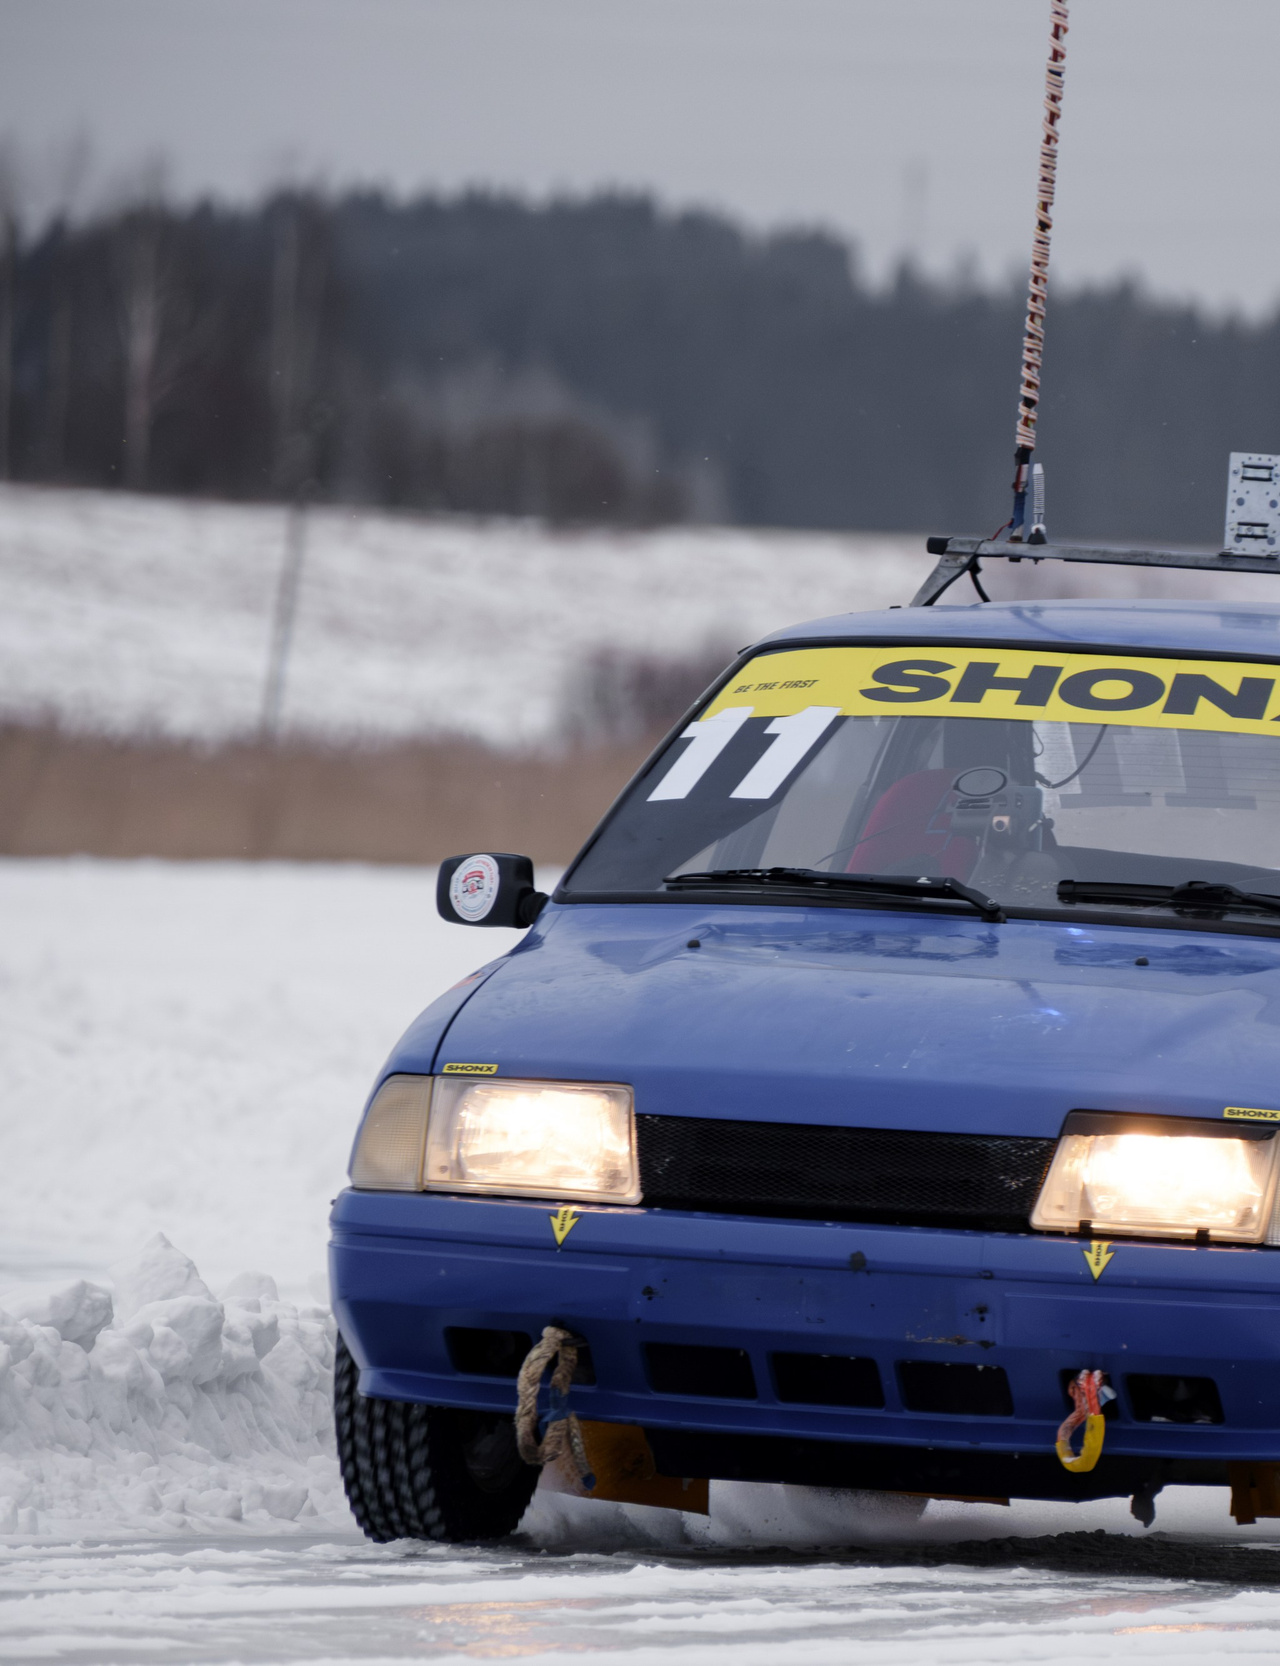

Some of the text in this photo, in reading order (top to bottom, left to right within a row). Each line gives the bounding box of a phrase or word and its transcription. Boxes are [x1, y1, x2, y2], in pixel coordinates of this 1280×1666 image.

[733, 679, 820, 694] BE THE FIRST
[646, 706, 842, 802] 11
[446, 1064, 494, 1072] SHONX
[1227, 1108, 1279, 1119] SHONX
